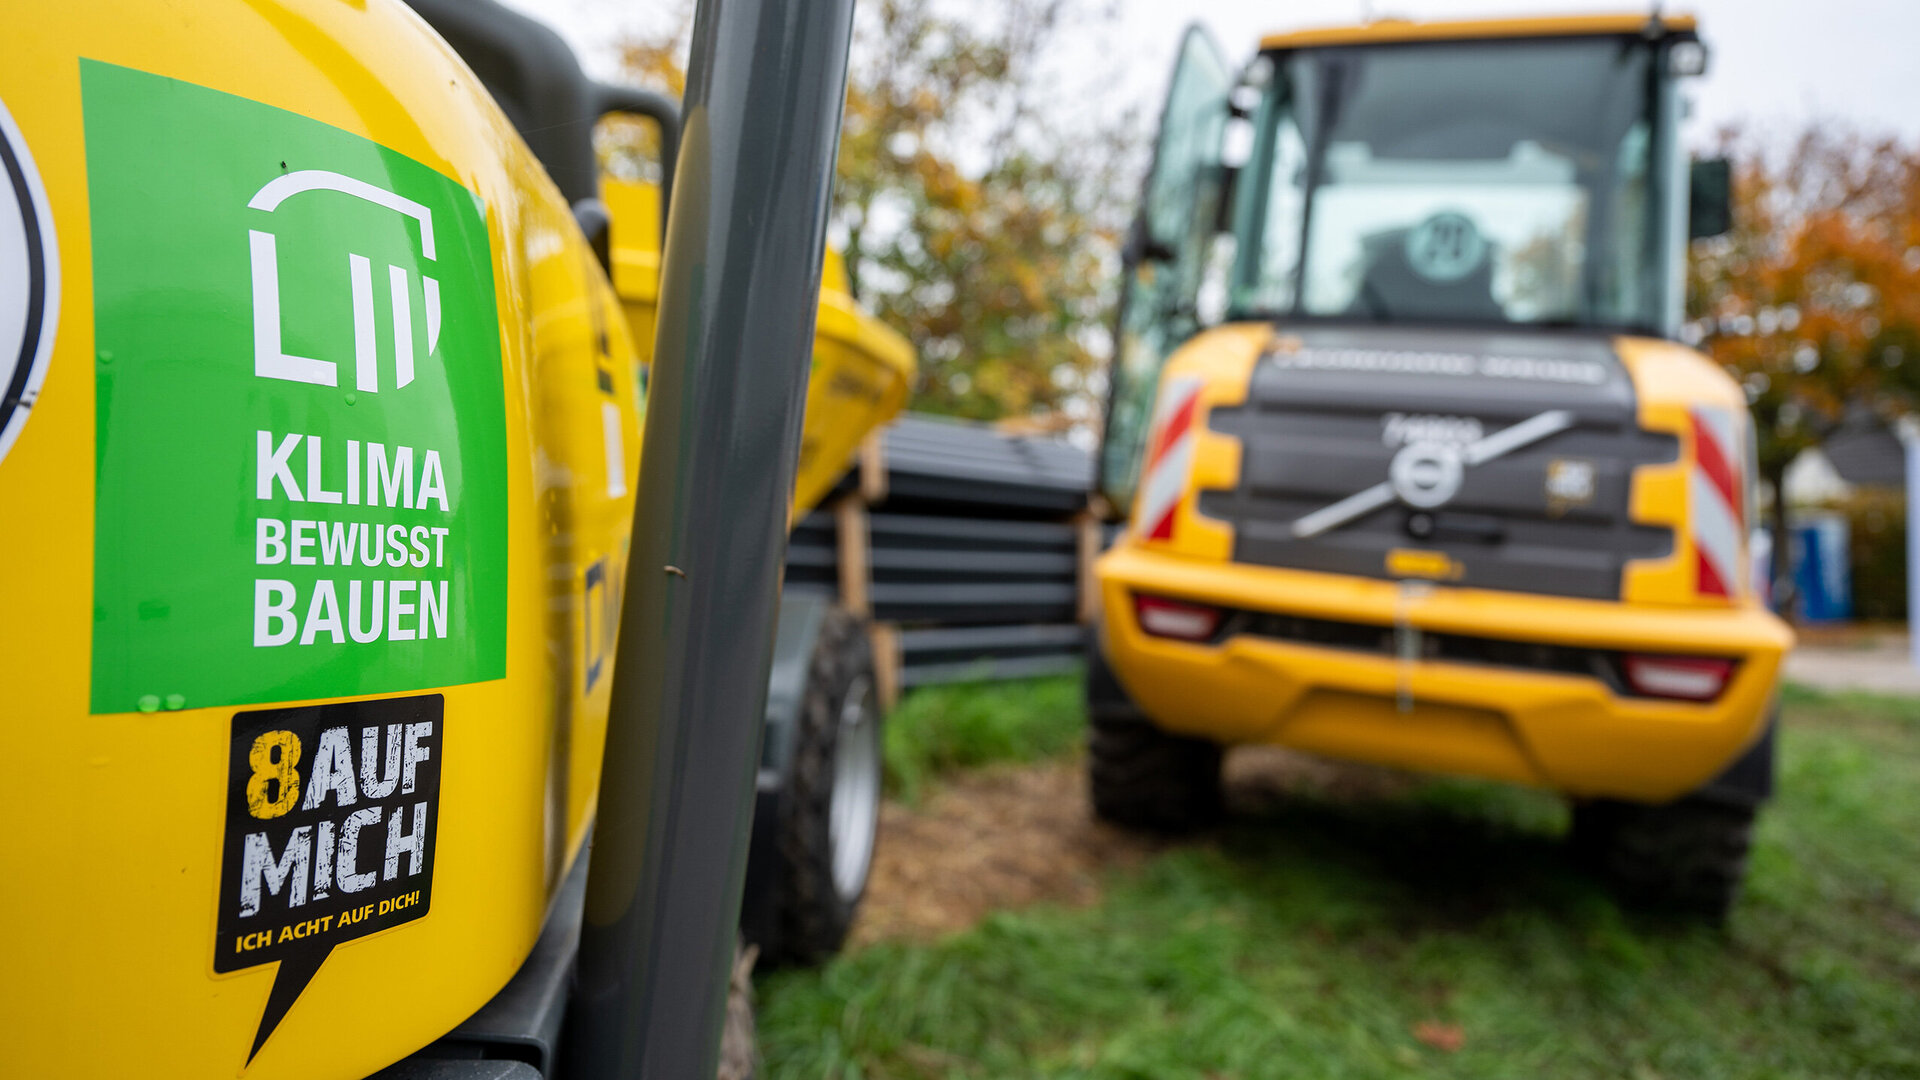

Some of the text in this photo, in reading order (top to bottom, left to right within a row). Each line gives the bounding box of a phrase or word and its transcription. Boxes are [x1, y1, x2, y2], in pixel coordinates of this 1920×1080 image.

[256, 430, 450, 512] KLIMA
[256, 518, 450, 568] BEWUSST
[253, 579, 449, 647] BAUEN
[239, 801, 428, 918] MICH
[235, 890, 421, 953] ICH ACHT AUF DICH!
